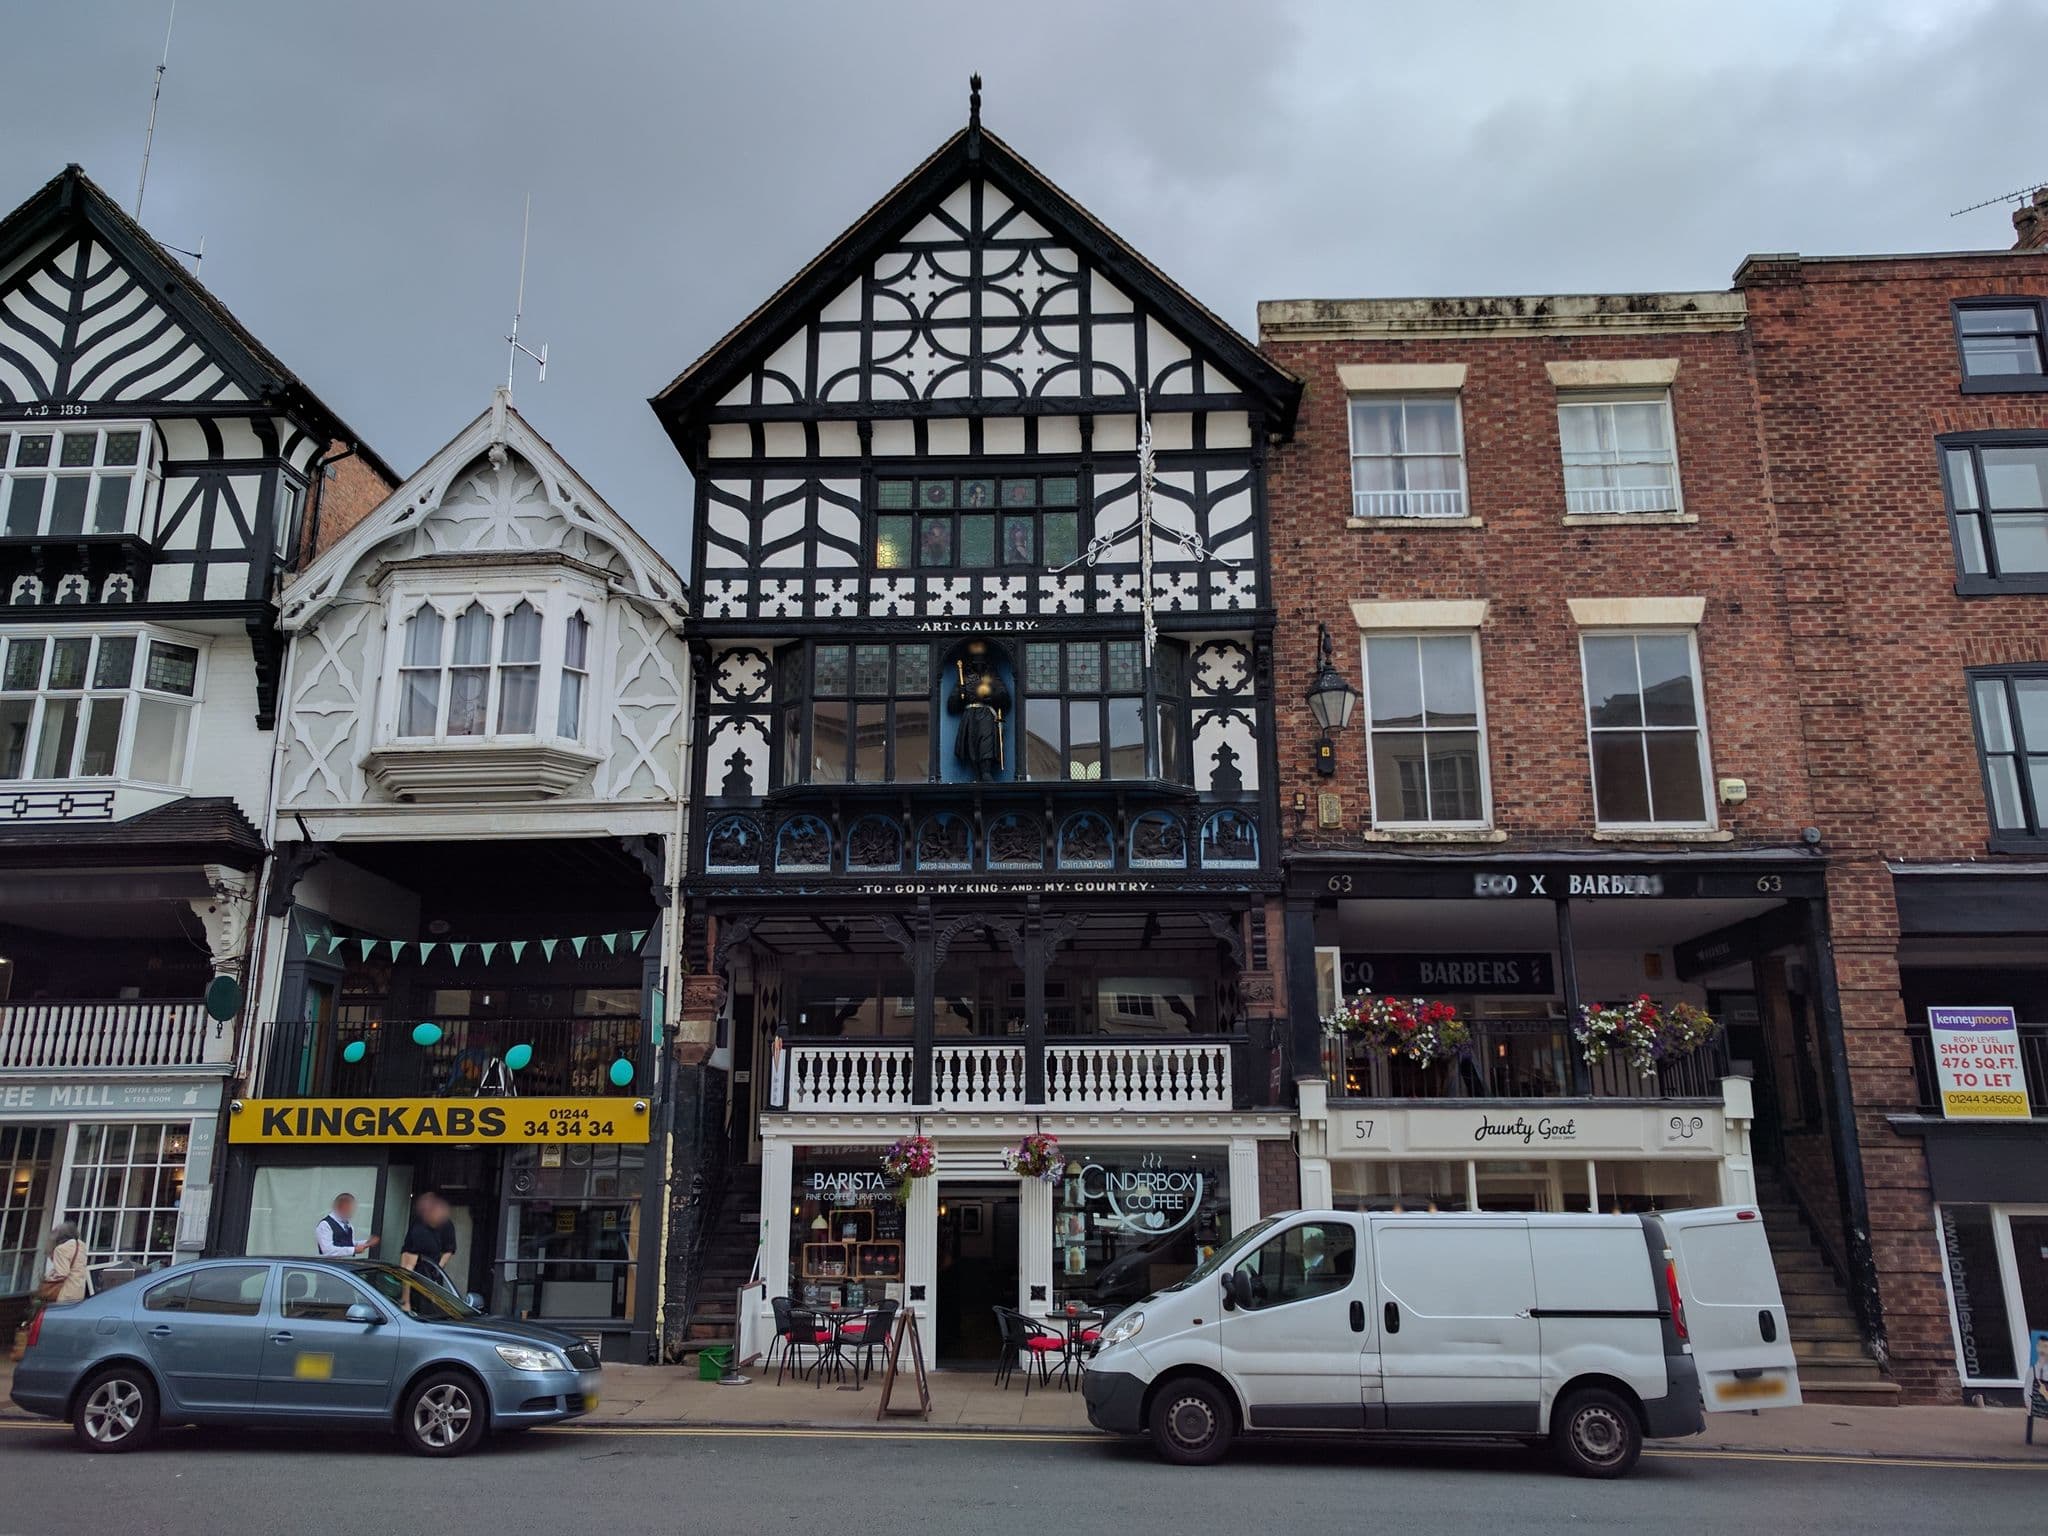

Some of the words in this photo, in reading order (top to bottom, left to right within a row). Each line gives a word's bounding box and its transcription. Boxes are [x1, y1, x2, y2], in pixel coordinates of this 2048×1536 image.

[60, 405, 87, 415] 1891
[921, 622, 952, 631] ART
[961, 621, 1033, 631] GALLERY
[865, 884, 881, 893] TO
[895, 884, 925, 893] GOD
[938, 884, 956, 893] MY
[967, 883, 998, 893] KING
[1011, 884, 1032, 892] AND
[1045, 883, 1064, 892] MY
[1074, 882, 1148, 892] COUNTRY
[1327, 875, 1353, 893] 63
[1530, 875, 1546, 894] X
[1757, 875, 1783, 892] 63
[1419, 961, 1520, 985] BARBERS
[1935, 1013, 2009, 1027] kenneymoore
[1977, 1036, 2000, 1044] LEVEL
[1940, 1044, 1978, 1054] SHOP
[1983, 1044, 2015, 1054] UNIT
[1942, 1058, 1970, 1069] 476
[1974, 1058, 2018, 1070] SQ.FT.
[1953, 1073, 1977, 1087] TO
[1984, 1073, 2011, 1087] LET
[0, 1086, 36, 1107] EE
[49, 1085, 114, 1107] MILL
[1948, 1094, 1980, 1104] 01244
[1982, 1095, 2023, 1104] 345600
[550, 1109, 590, 1119] 01244
[262, 1107, 507, 1137] KINGKABS
[524, 1121, 549, 1136] 34
[556, 1121, 582, 1136] 34
[588, 1121, 614, 1136] 34
[1356, 1120, 1374, 1139] 57
[1475, 1115, 1535, 1144] Jaunty
[1538, 1118, 1576, 1139] Goat
[813, 1172, 885, 1190] BARISTA
[1079, 1164, 1194, 1199] CINDERBOX
[805, 1193, 821, 1201] FINE
[823, 1193, 851, 1201] COFFEE
[1126, 1193, 1184, 1209] COFFEE
